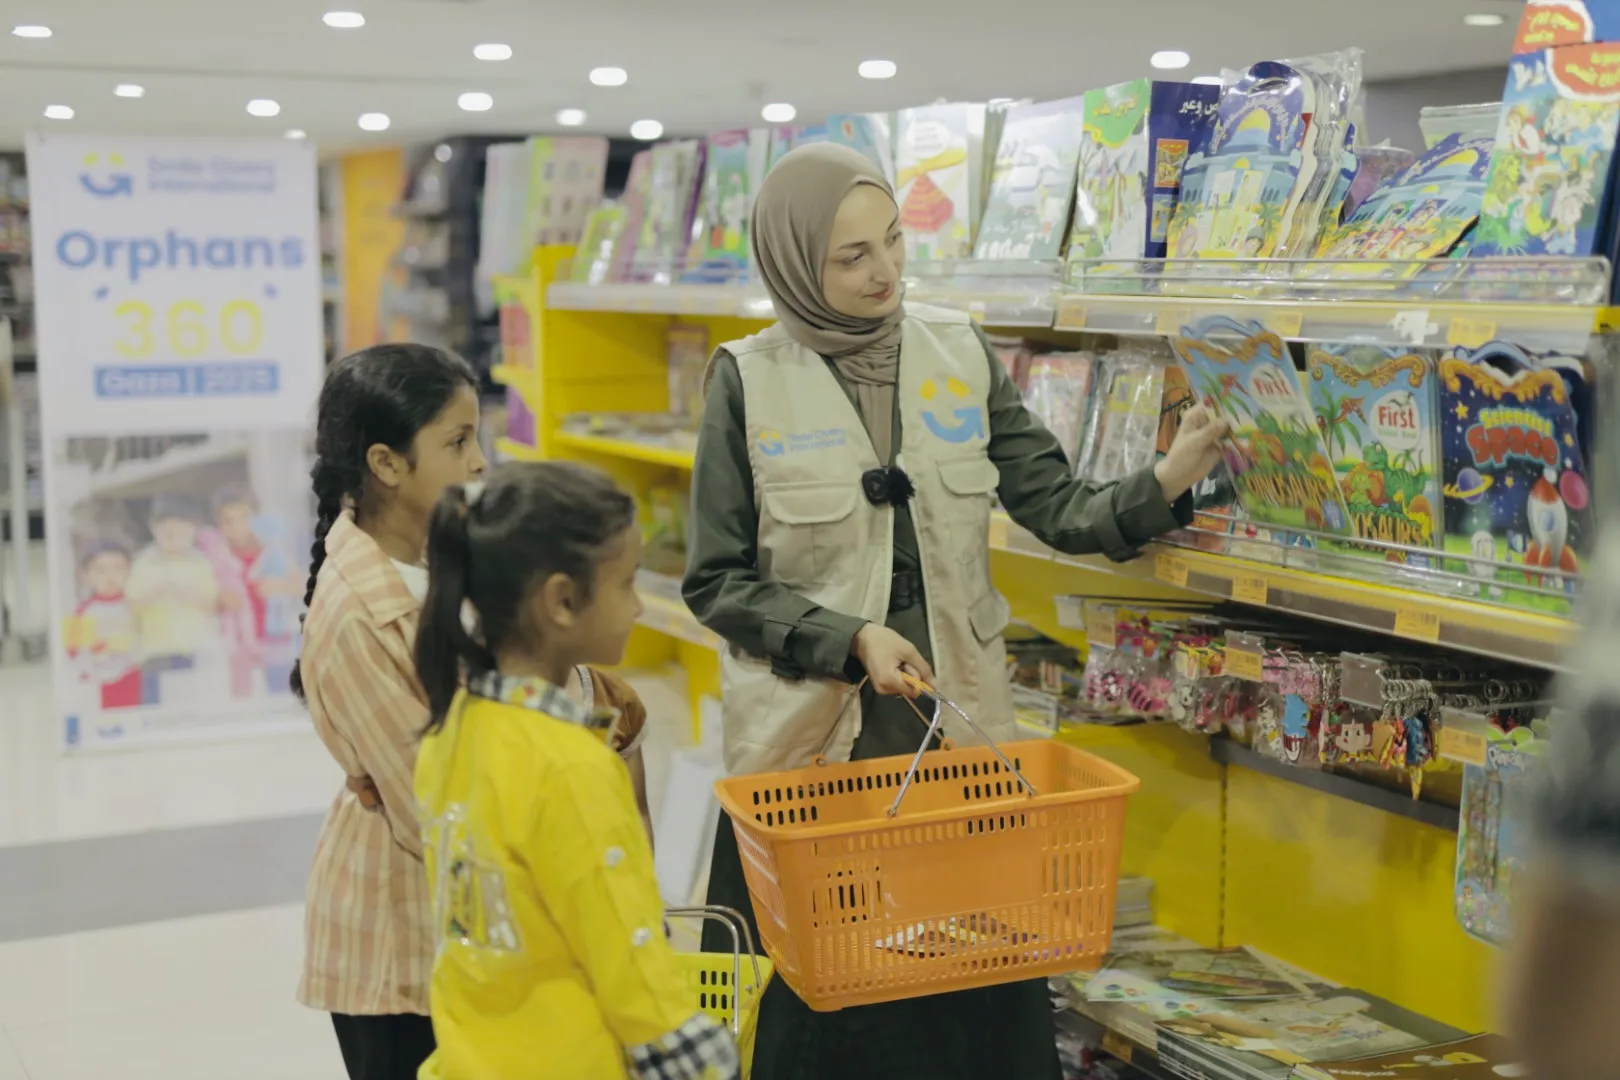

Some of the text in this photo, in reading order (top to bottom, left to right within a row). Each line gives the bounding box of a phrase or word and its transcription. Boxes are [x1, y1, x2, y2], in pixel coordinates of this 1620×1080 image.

[56, 229, 304, 282] Orphans
[114, 300, 264, 357] 360
[1252, 377, 1291, 396] First
[1378, 405, 1416, 429] First
